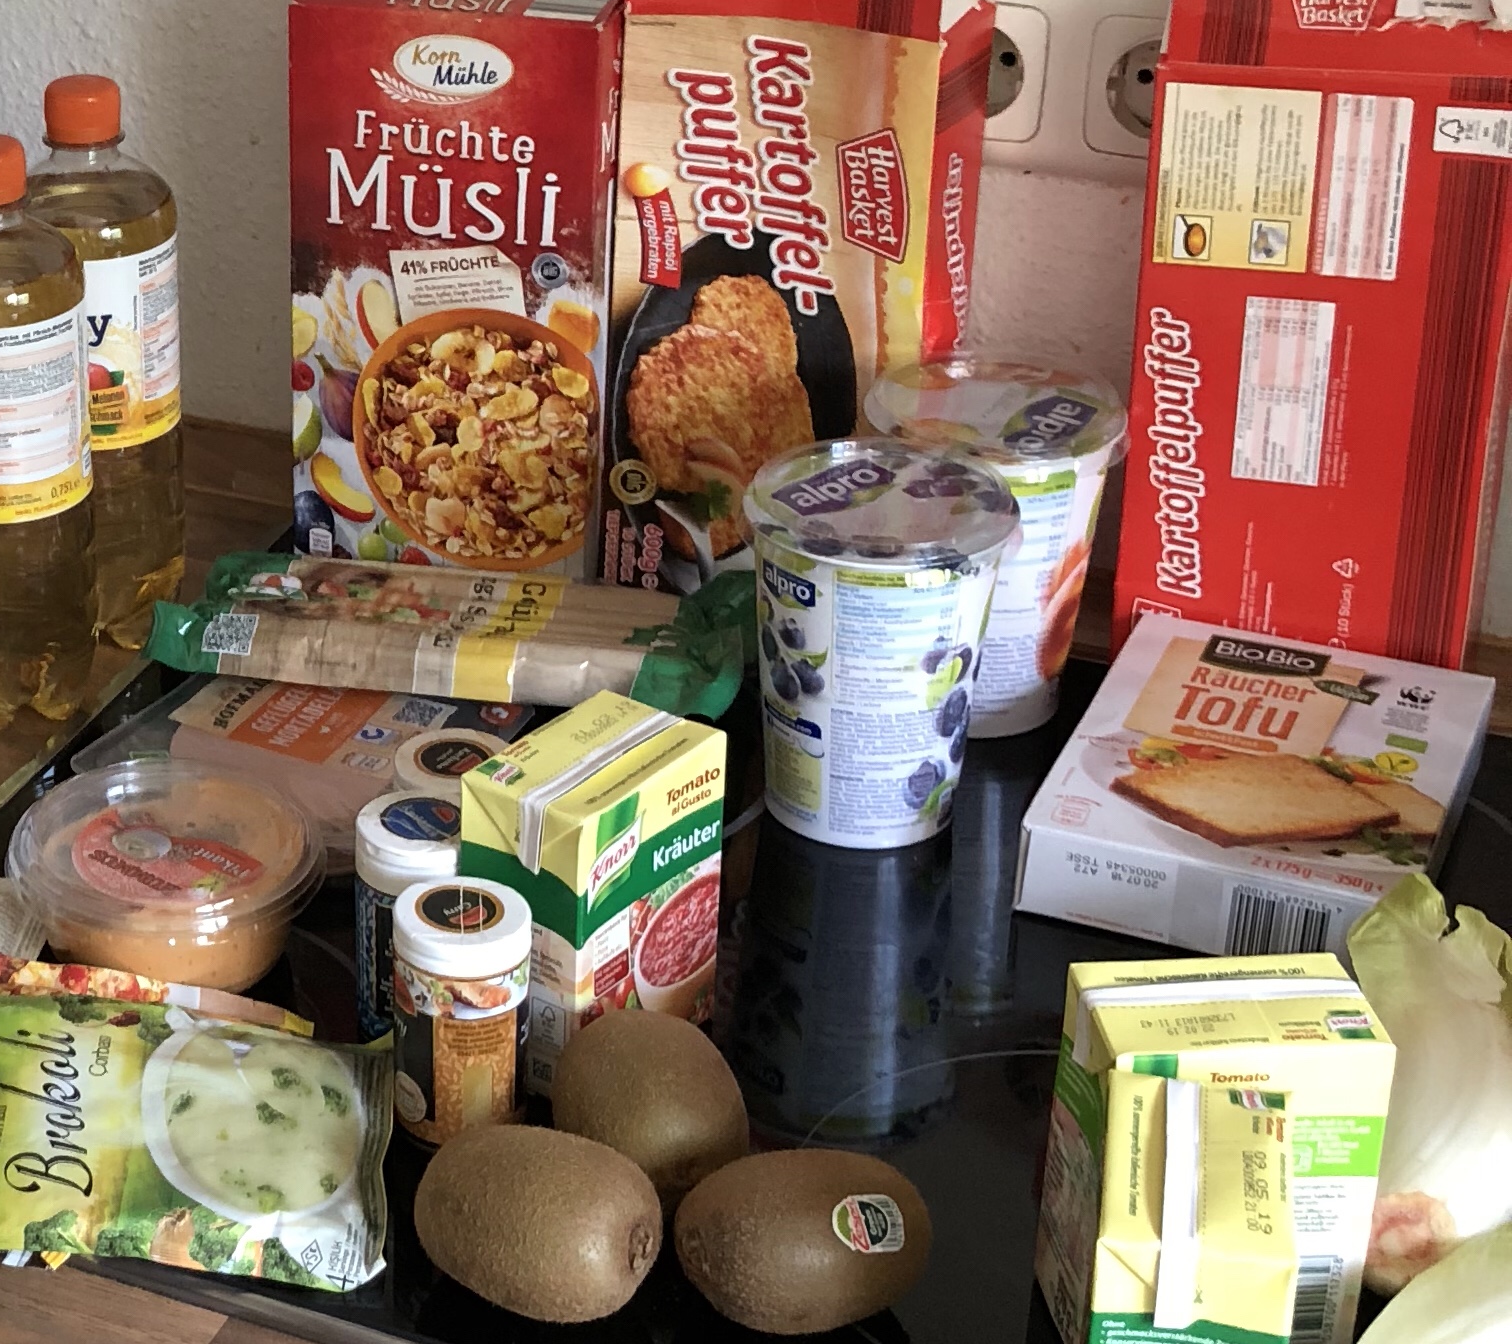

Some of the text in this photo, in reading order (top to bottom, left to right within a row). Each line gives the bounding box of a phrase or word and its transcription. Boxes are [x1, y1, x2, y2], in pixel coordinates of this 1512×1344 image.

[1301, 6, 1368, 26] Basket
[411, 43, 462, 66] Korn
[432, 60, 499, 87] Mühle
[354, 109, 536, 164] Früchte
[668, 69, 756, 250] puffer
[325, 147, 562, 248] Müsli
[748, 35, 836, 316] Kartoffel-
[844, 150, 875, 241] Basket
[867, 145, 898, 247] Harvest
[400, 255, 501, 276] 41% FRÜCHTE
[1144, 307, 1207, 599] Kartoffelpuffer
[788, 463, 881, 511] alpro
[764, 563, 812, 602] alpro
[1188, 666, 1317, 704] Räucher
[1173, 682, 1300, 742] Tofu
[665, 766, 721, 806] Tomato
[670, 787, 712, 817] al Gusto
[589, 834, 637, 893] Knorr
[652, 819, 721, 873] Kräuter
[1210, 1071, 1271, 1085] Tomato
